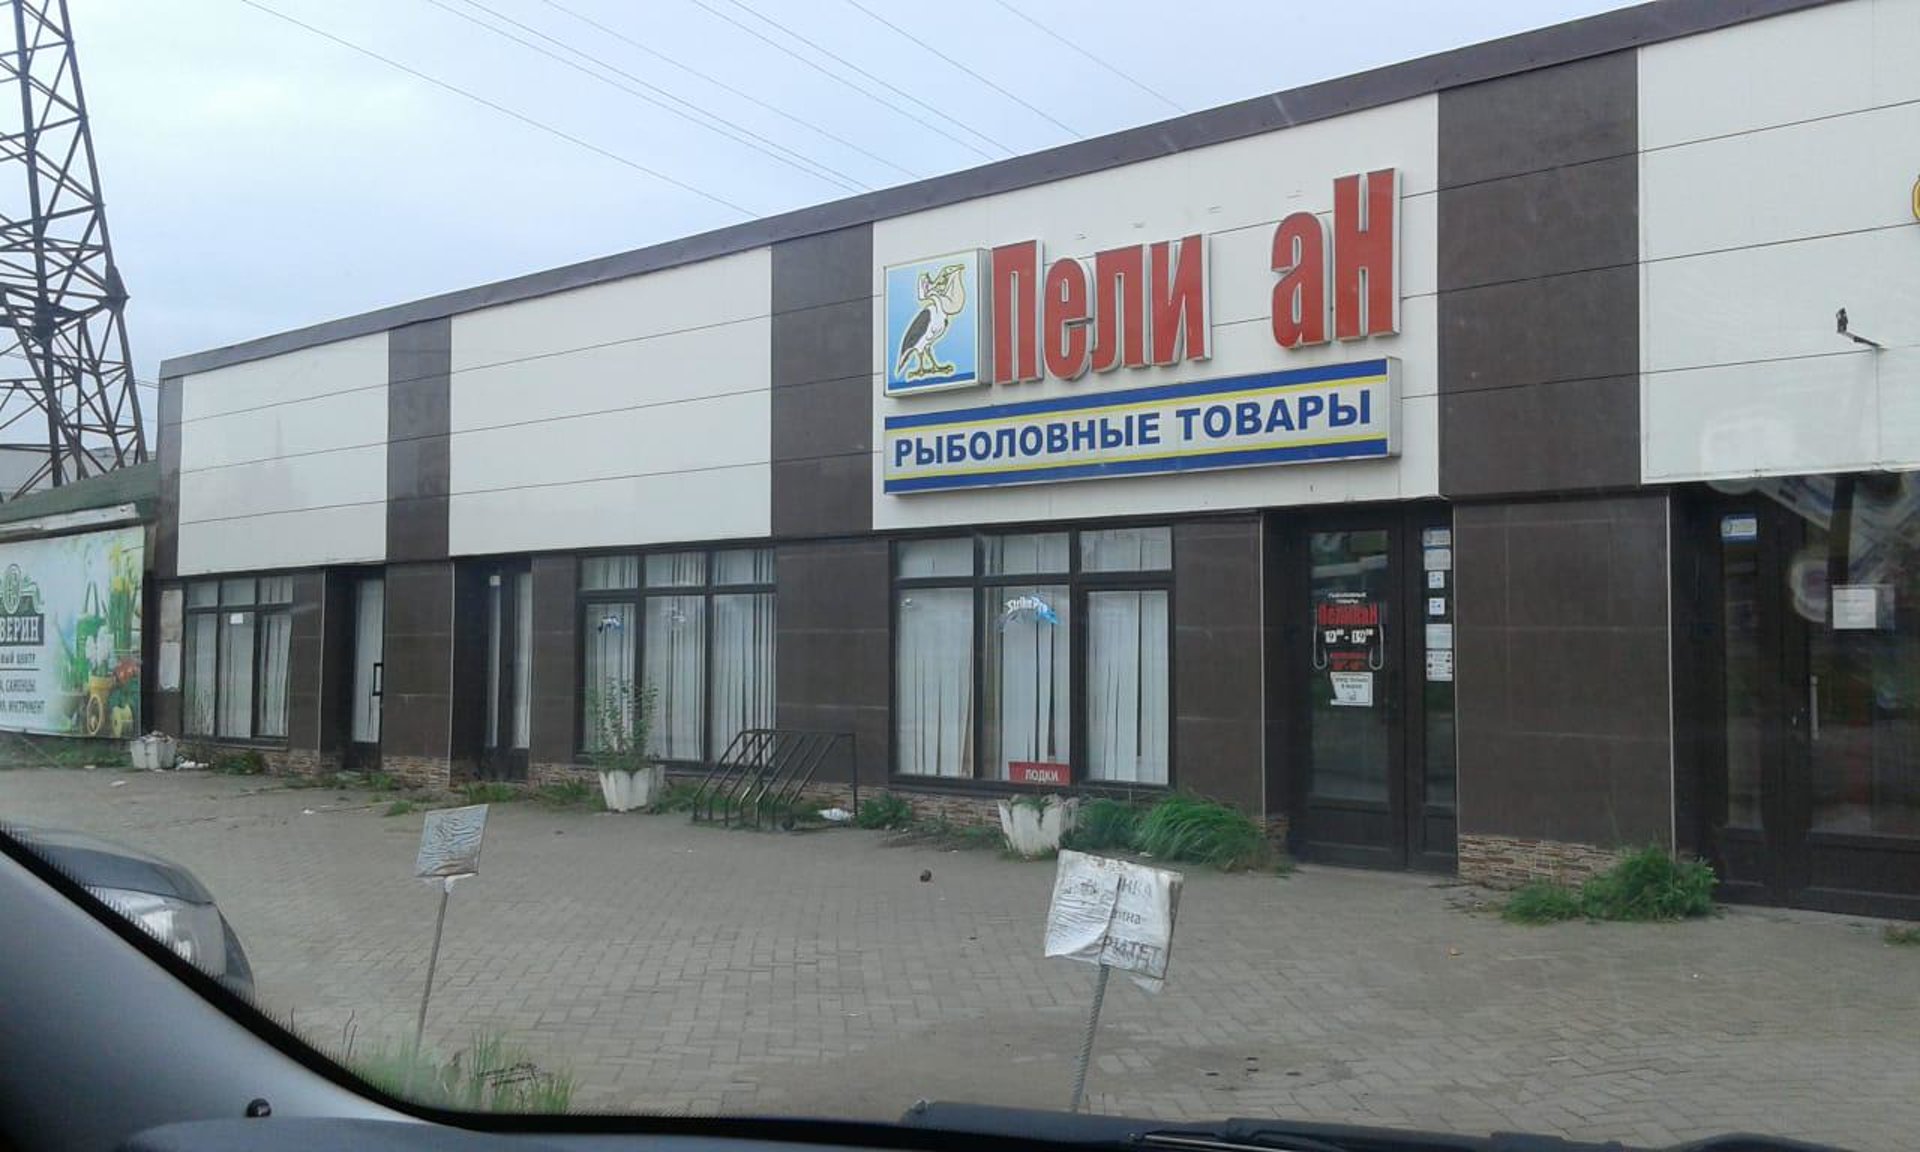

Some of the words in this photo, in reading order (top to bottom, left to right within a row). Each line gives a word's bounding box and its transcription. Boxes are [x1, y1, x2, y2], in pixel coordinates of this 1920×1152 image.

[894, 412, 1161, 467] РЫБОЛОВНЫЕ
[1176, 389, 1371, 442] ТОВАРЫ
[1025, 769, 1058, 784] ЛОДКИ
